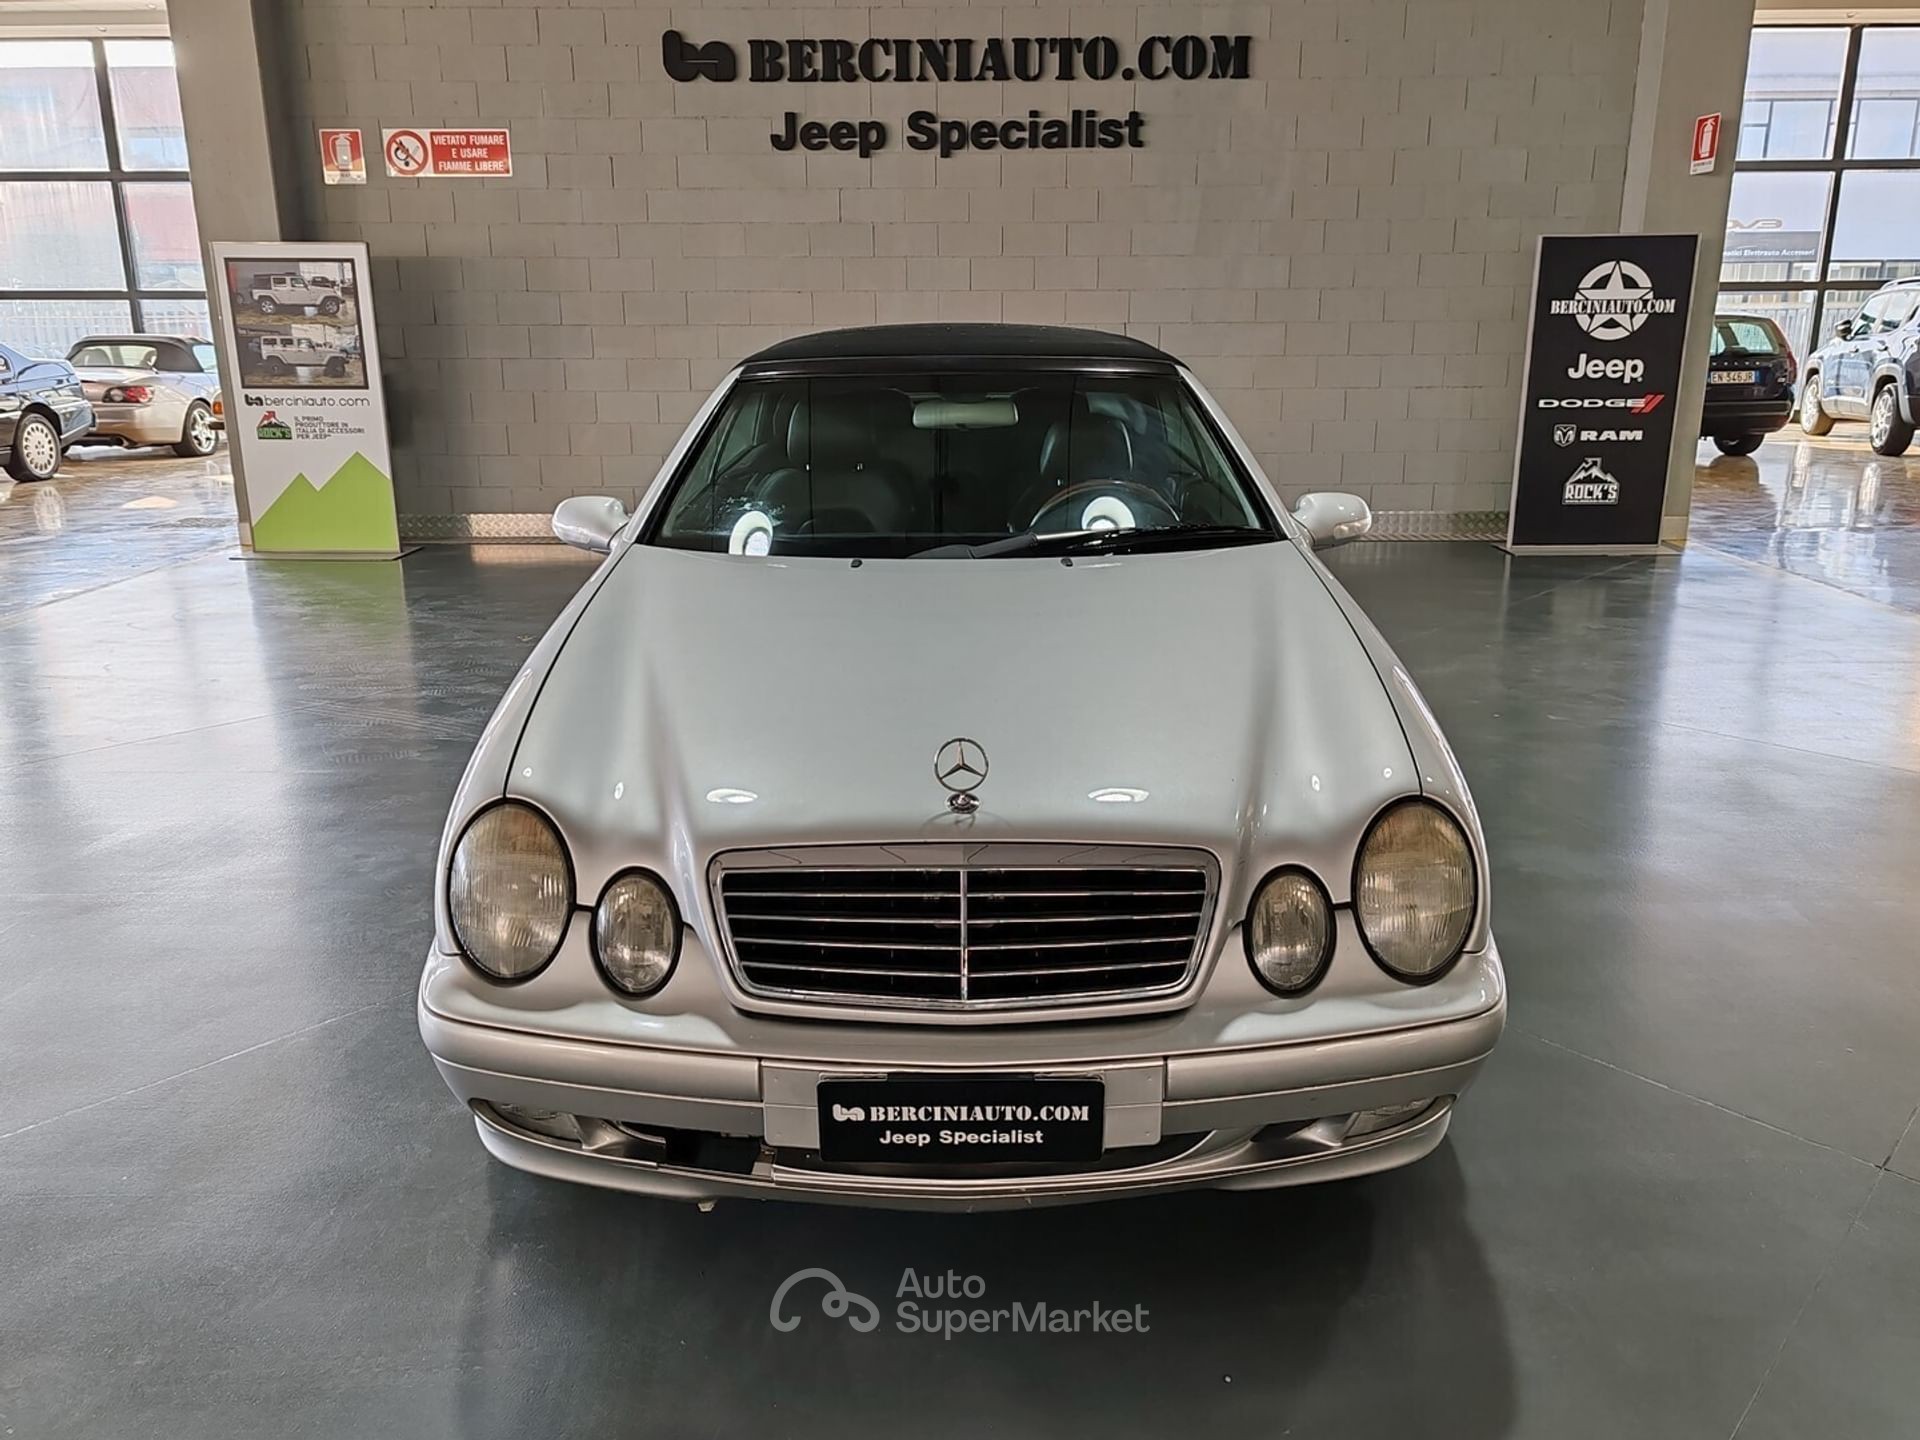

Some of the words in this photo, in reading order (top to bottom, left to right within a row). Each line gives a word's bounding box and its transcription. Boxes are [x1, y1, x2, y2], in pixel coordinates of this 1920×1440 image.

[748, 35, 1252, 82] BERCINIAUTO.COM
[432, 135, 467, 145] VIETATO
[469, 135, 505, 145] FUMARE
[770, 112, 887, 158] Jeep
[906, 110, 1144, 157] Specialist
[451, 148, 458, 158] E
[460, 148, 488, 158] USARE
[438, 161, 472, 171] FIAMME
[474, 161, 504, 171] LIBERE
[1550, 299, 1676, 315] BERCINIAUTO.COM
[1567, 353, 1644, 383] Jeep
[264, 395, 370, 406] berciniauto.com
[1538, 398, 1646, 408] DODGE
[1580, 430, 1643, 441] RAM
[1565, 484, 1617, 499] ROCK'S
[870, 1105, 1089, 1121] BERCINIAUTO.COM
[879, 1130, 931, 1146] Jeep
[939, 1130, 1043, 1144] Specialist
